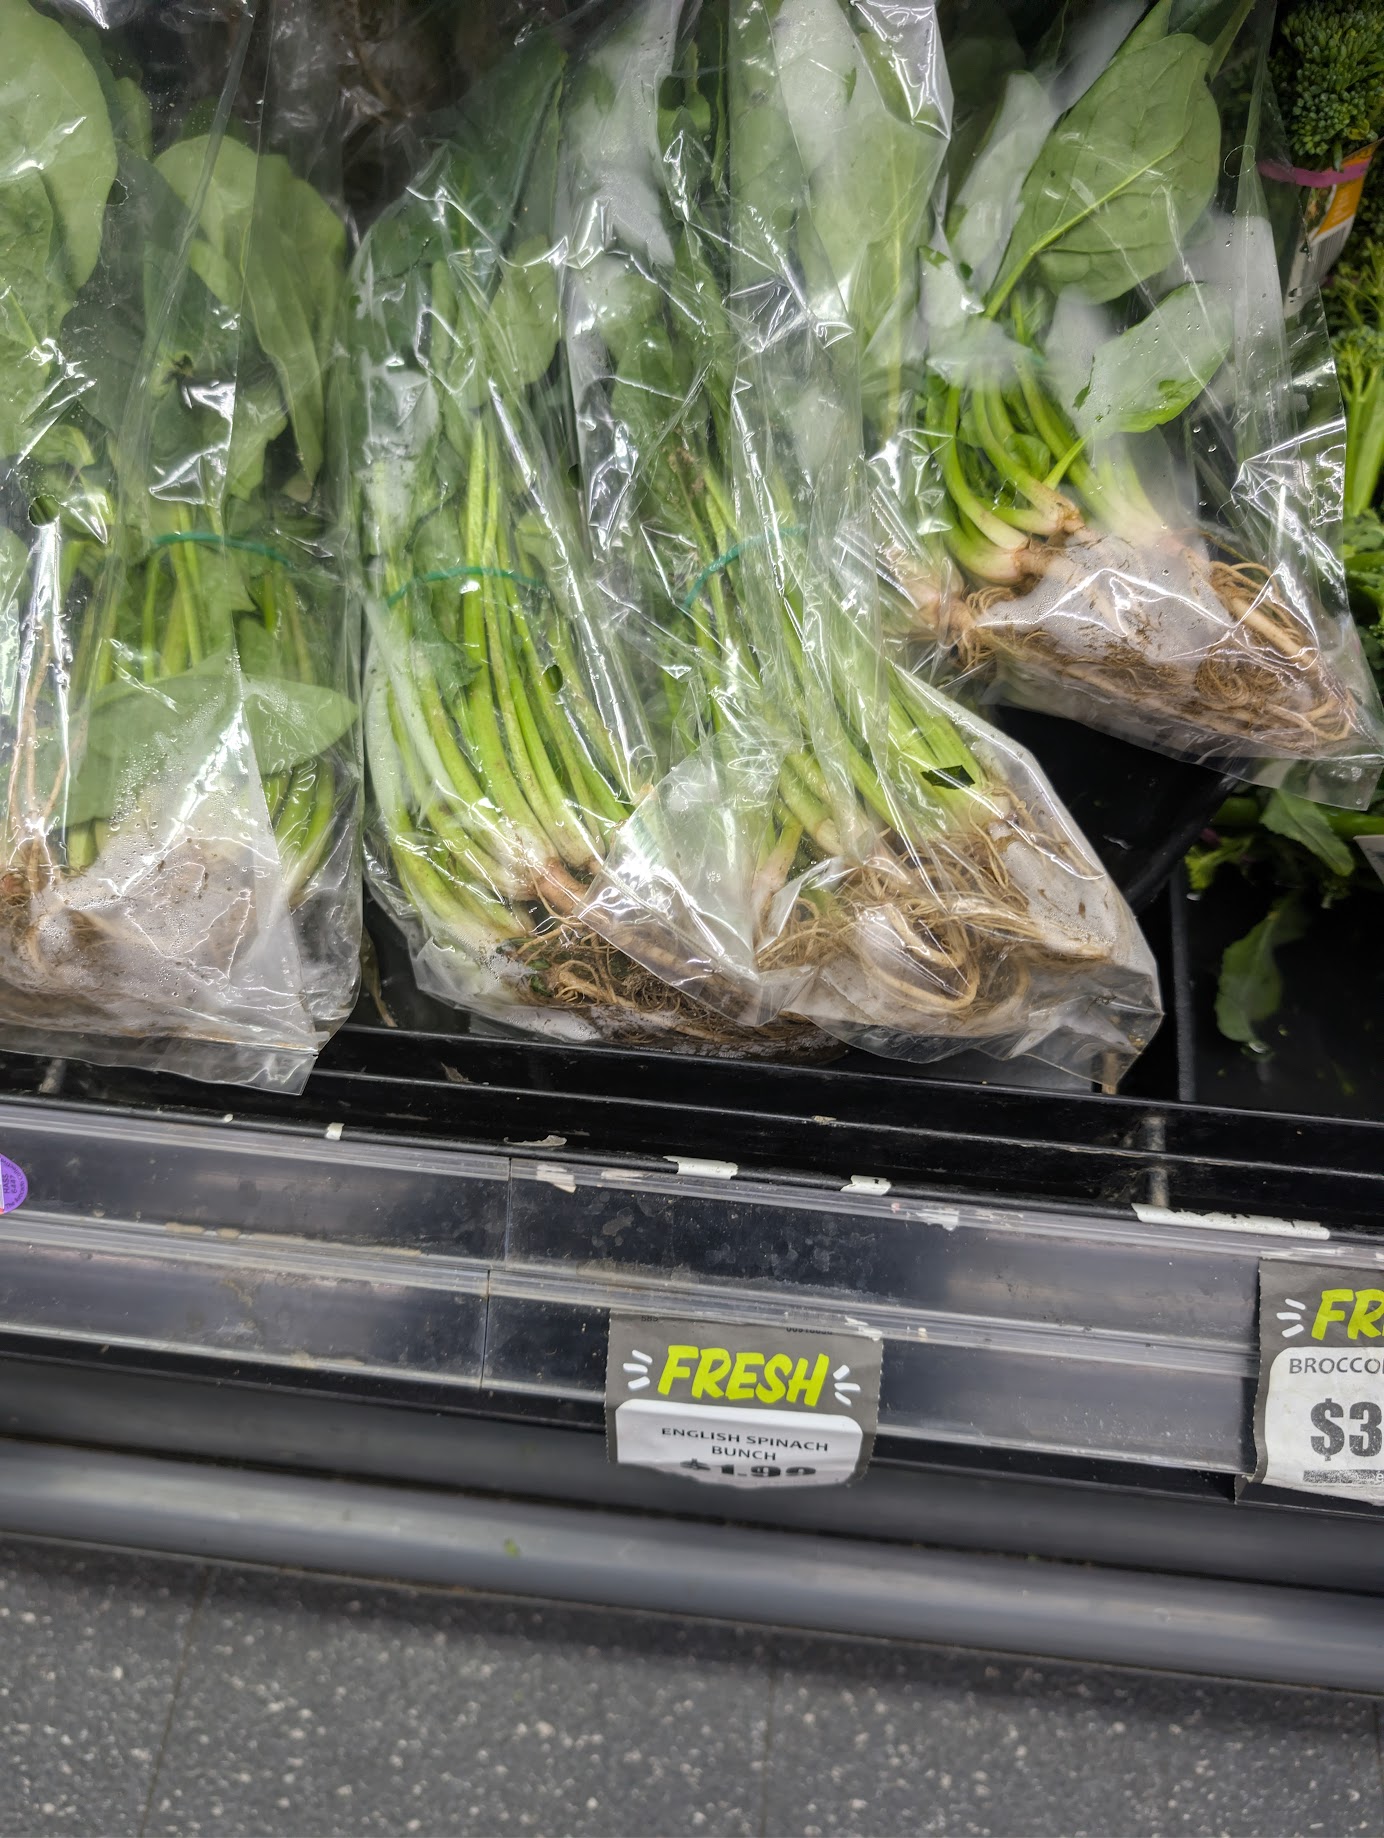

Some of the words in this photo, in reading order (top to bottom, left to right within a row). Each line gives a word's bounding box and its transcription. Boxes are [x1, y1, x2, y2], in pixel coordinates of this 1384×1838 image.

[2, 1173, 10, 1194] HASS
[1311, 1288, 1384, 1340] FR
[657, 1344, 830, 1407] FRESH
[661, 1427, 740, 1443] ENGLISH
[746, 1435, 828, 1451] SPINACH
[711, 1446, 776, 1461] BUNCH
